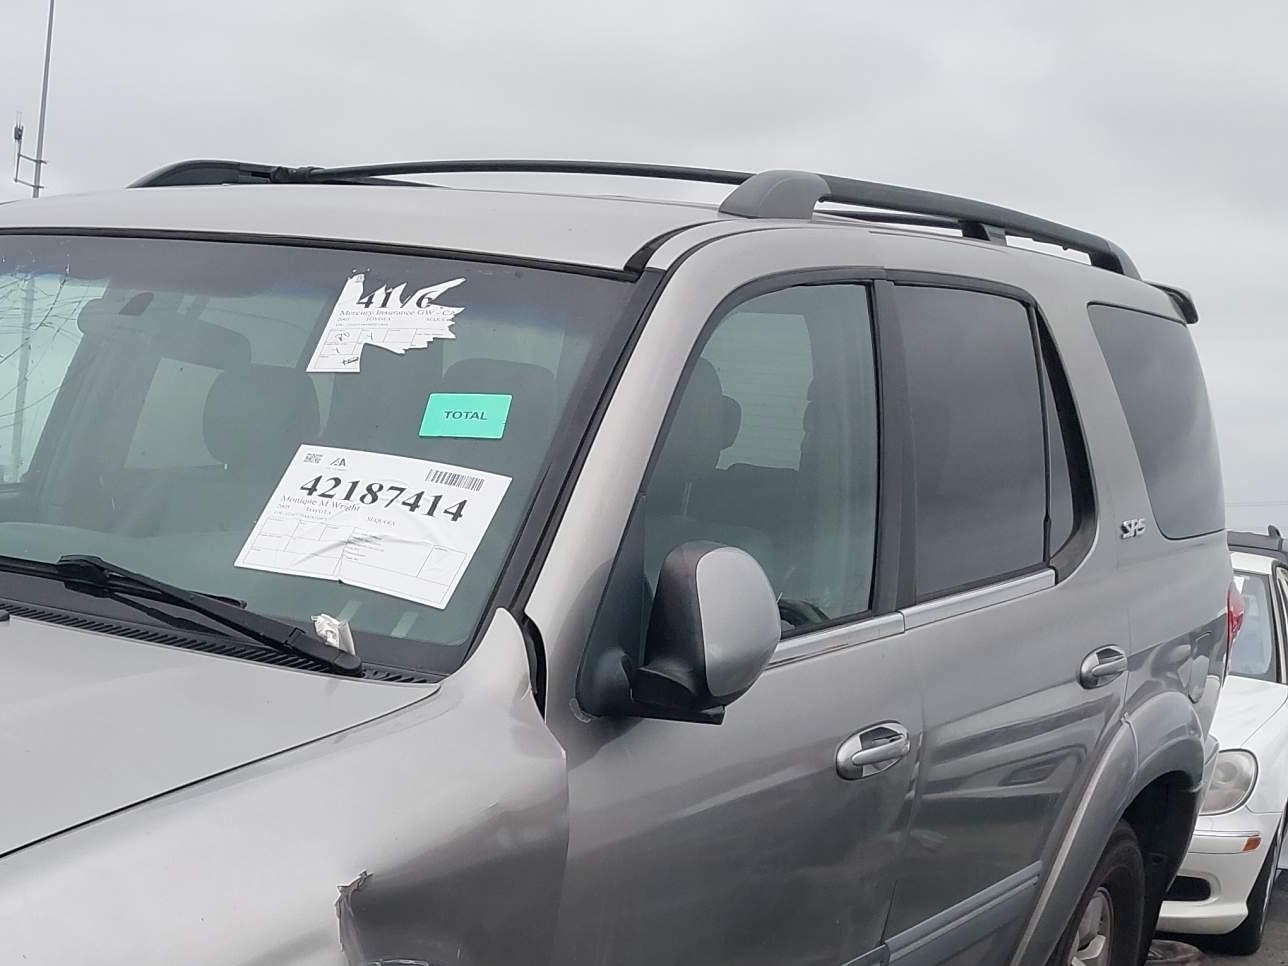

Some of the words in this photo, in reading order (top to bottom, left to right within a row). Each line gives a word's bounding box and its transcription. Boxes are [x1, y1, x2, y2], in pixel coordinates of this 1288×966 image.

[339, 309, 373, 317] Mercury
[444, 410, 488, 421] TOTAL
[281, 495, 316, 506] Monique
[332, 501, 361, 512] Wright
[299, 475, 468, 522] 42187414
